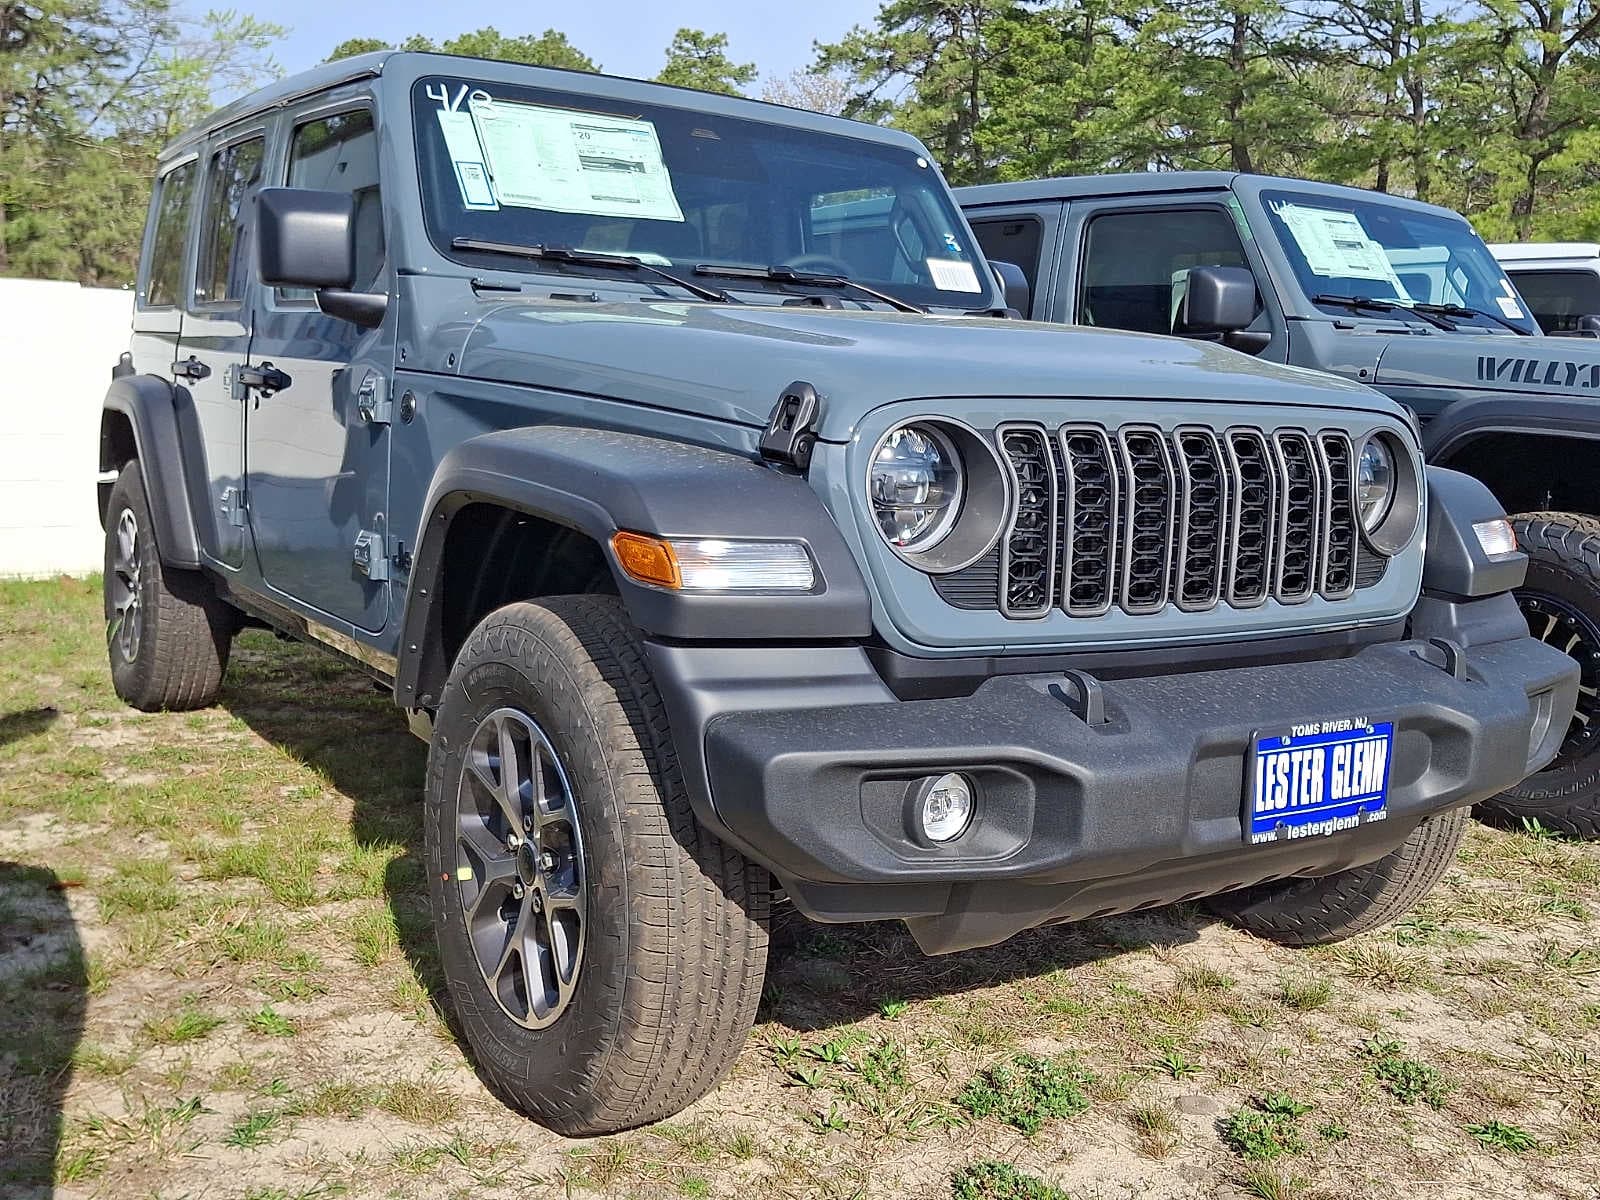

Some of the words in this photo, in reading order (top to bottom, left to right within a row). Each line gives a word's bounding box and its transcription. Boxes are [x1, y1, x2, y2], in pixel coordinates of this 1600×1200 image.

[1291, 723, 1320, 737] TOMS
[1322, 719, 1353, 734] RIVER,
[1355, 716, 1368, 730] NJ
[1255, 748, 1325, 813] LESTER
[1331, 739, 1388, 800] GLENN
